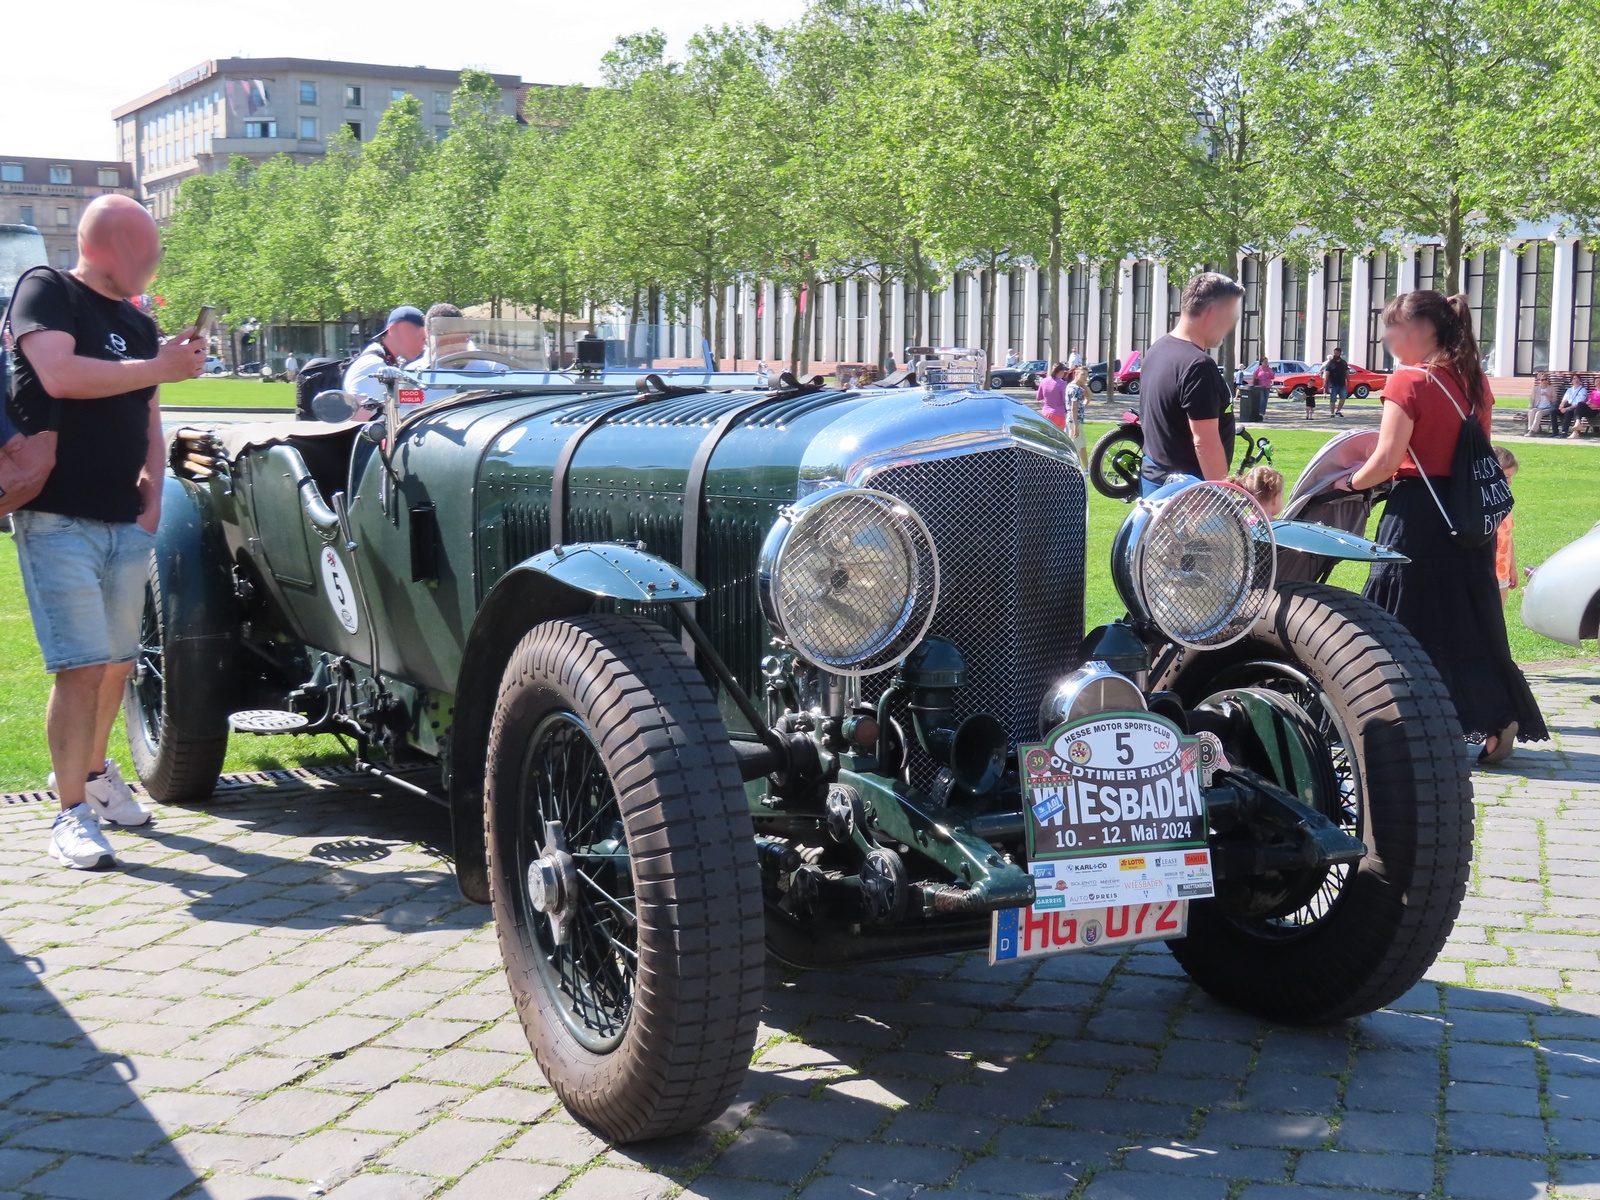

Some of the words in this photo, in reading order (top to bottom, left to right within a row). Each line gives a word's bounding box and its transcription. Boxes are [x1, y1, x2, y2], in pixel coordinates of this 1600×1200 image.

[332, 572, 345, 605] 5
[1064, 727, 1091, 744] HESSE
[1093, 722, 1122, 733] MOTOR
[1124, 722, 1152, 732] SPORTS
[1153, 727, 1171, 739] CLUB
[1115, 732, 1134, 765] 5
[1032, 756, 1044, 767] 39
[1050, 756, 1137, 781] OLDTIMER
[1055, 830, 1083, 848] 10.
[1102, 826, 1126, 844] 12.
[1131, 823, 1157, 842] Mai
[1161, 821, 1192, 839] 2024
[1128, 858, 1144, 866] LOTTO
[1124, 880, 1163, 889] WIESBADEN
[1036, 897, 1062, 905] GARREIS
[1000, 938, 1010, 951] D
[1023, 904, 1077, 951] HG
